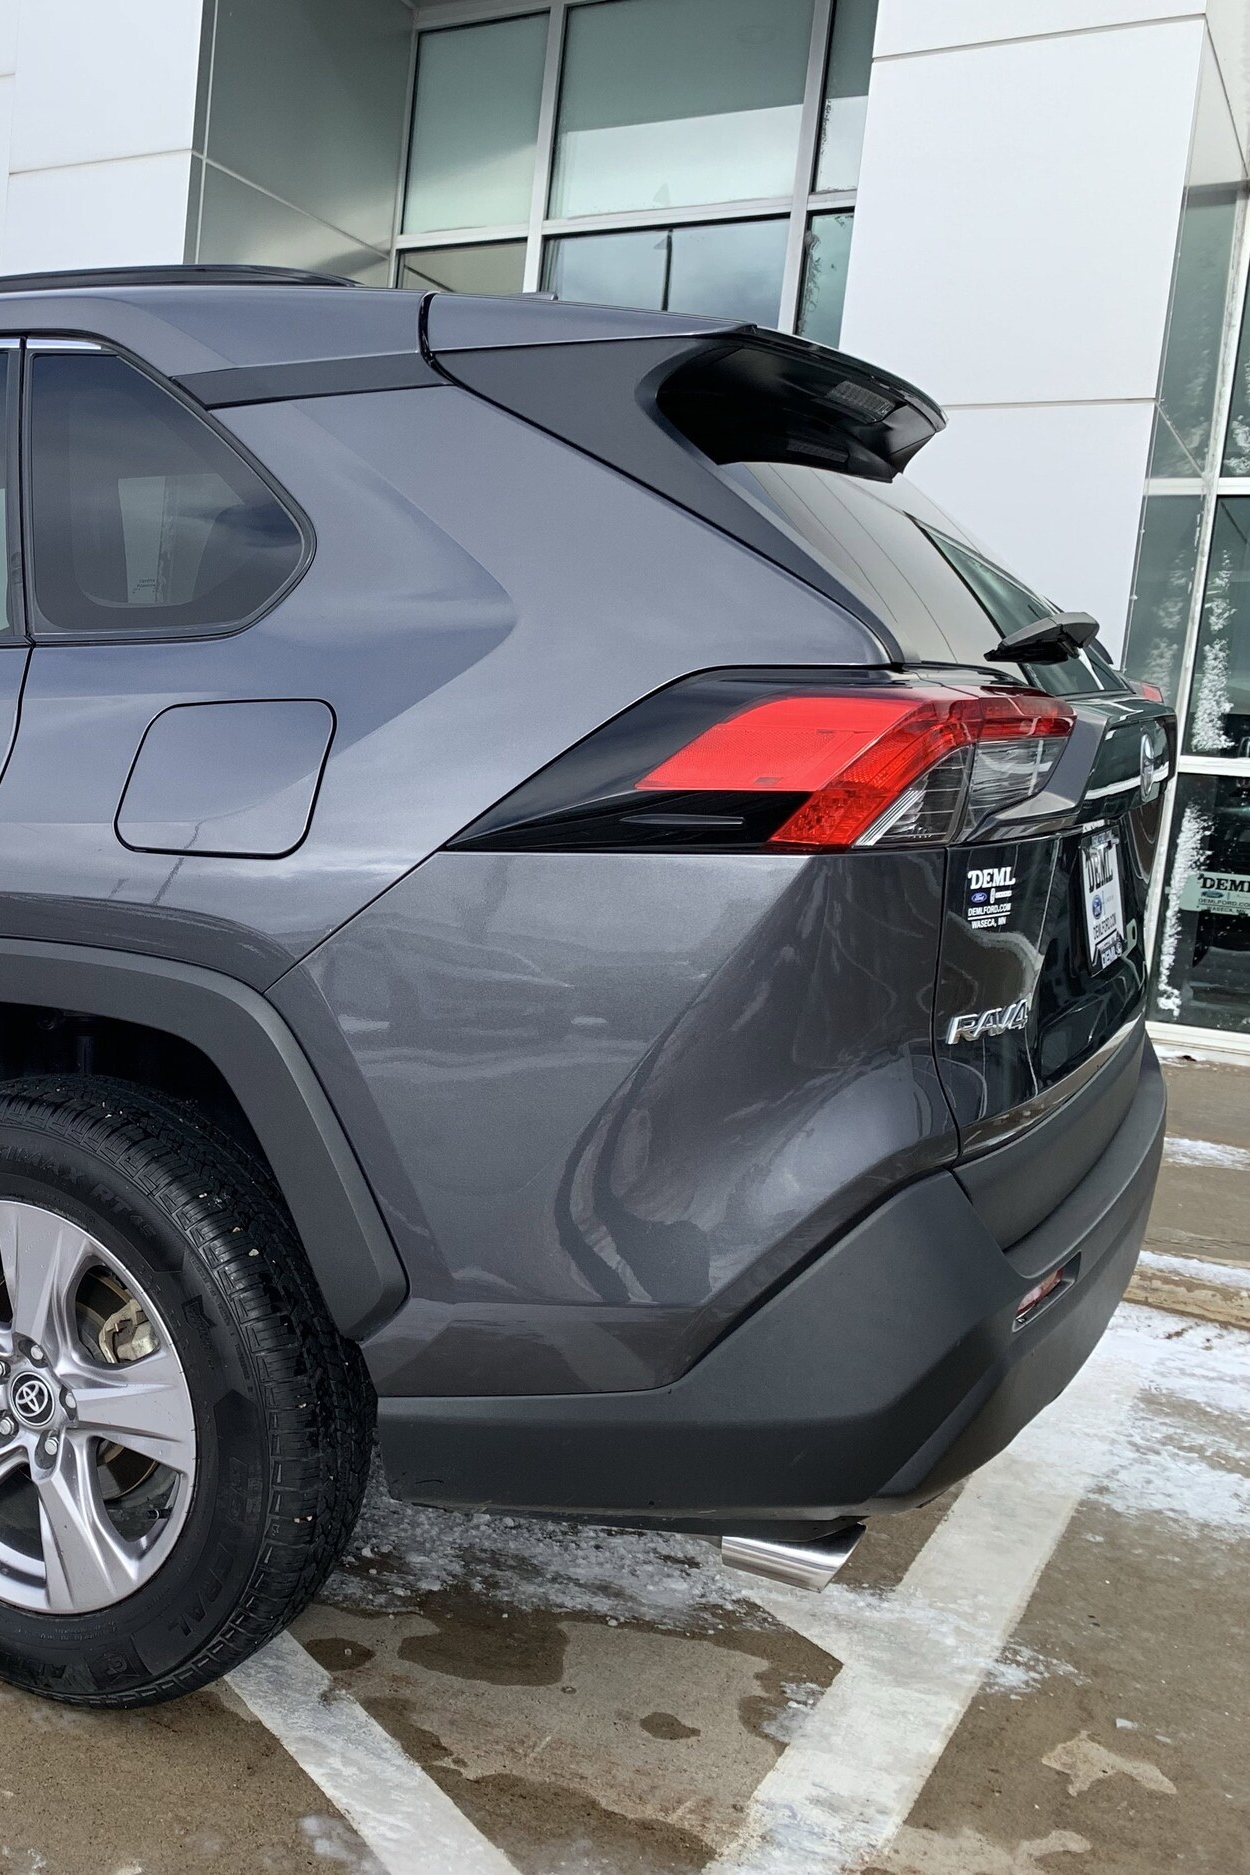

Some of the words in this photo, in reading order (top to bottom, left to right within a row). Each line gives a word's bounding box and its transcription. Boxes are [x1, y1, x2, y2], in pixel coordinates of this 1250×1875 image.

[967, 866, 1016, 890] DEML
[967, 903, 1012, 917] DEMLFORD.COM
[1198, 898, 1250, 908] DEMLFORD.CO
[971, 918, 997, 930] WASECA,
[998, 916, 1007, 926] MN
[945, 998, 1028, 1045] RAV4
